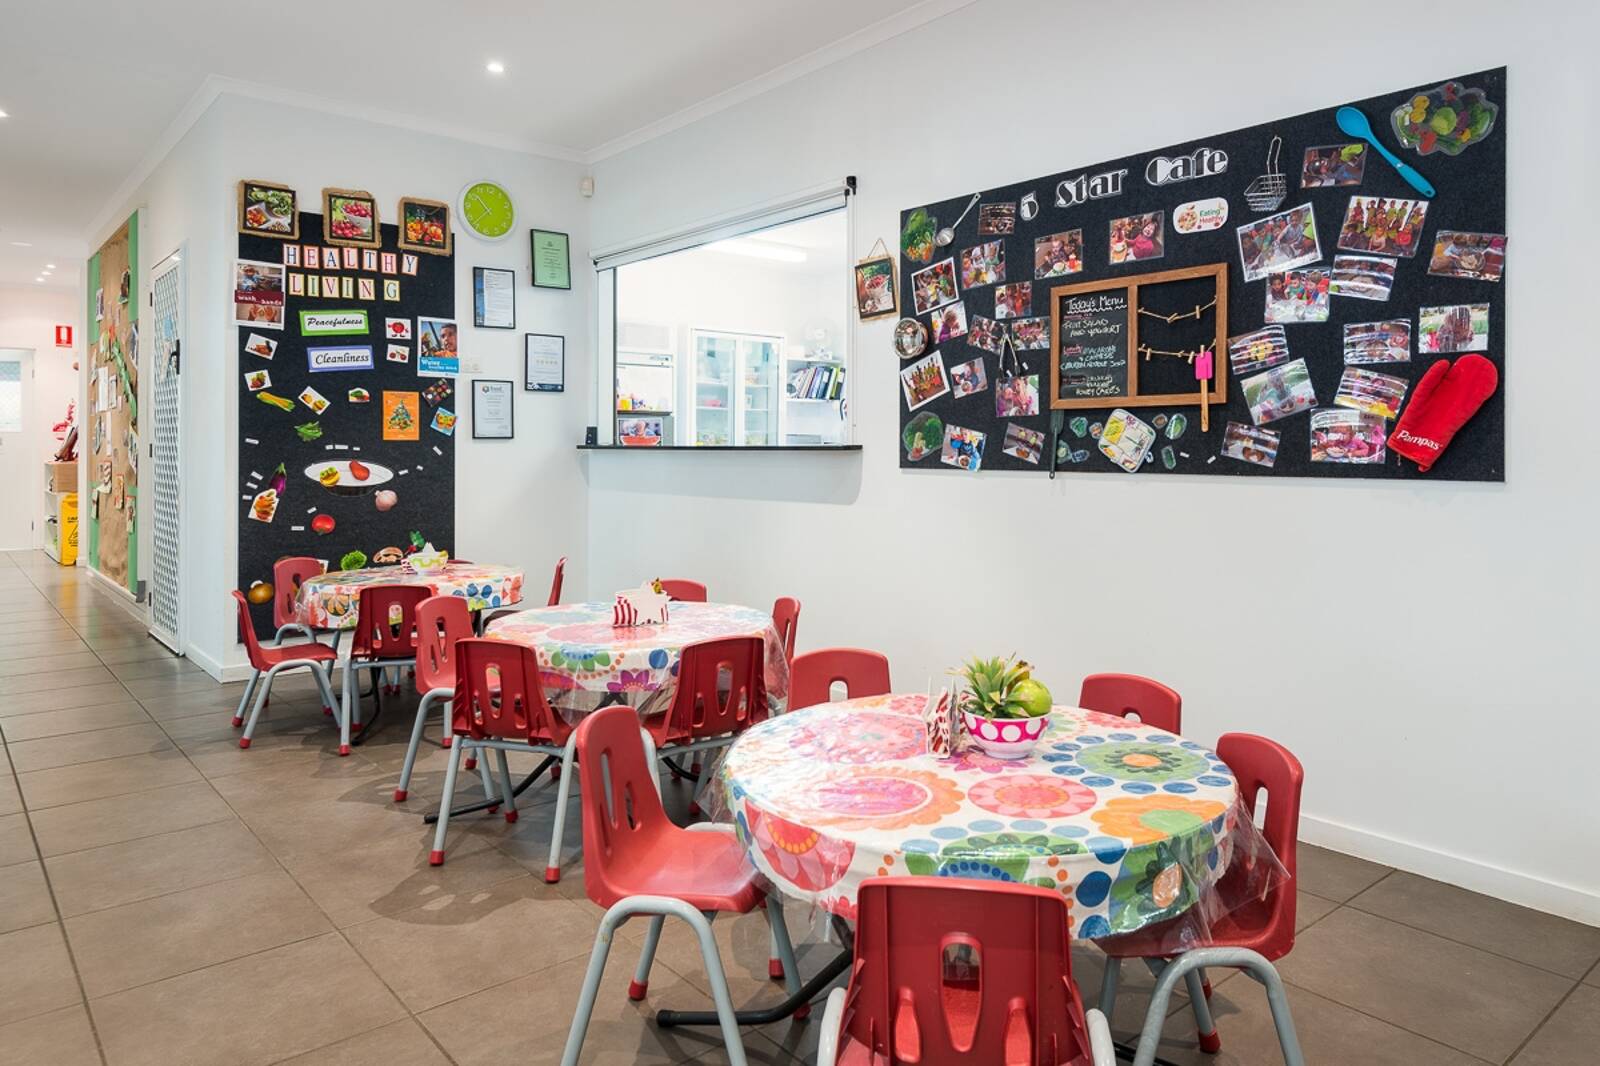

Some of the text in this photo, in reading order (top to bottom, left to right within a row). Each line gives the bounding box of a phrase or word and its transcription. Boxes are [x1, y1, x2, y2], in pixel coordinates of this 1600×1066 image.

[1055, 168, 1128, 208] Star
[1146, 148, 1228, 186] Cafe
[1199, 209, 1221, 217] Eating
[286, 246, 415, 273] HEALTHY
[292, 275, 397, 299] LIVING
[1064, 296, 1124, 312] Today's Menu
[307, 317, 363, 329] Peacefulness
[315, 353, 370, 365] Cleanliness
[1396, 430, 1439, 450] Pampas
